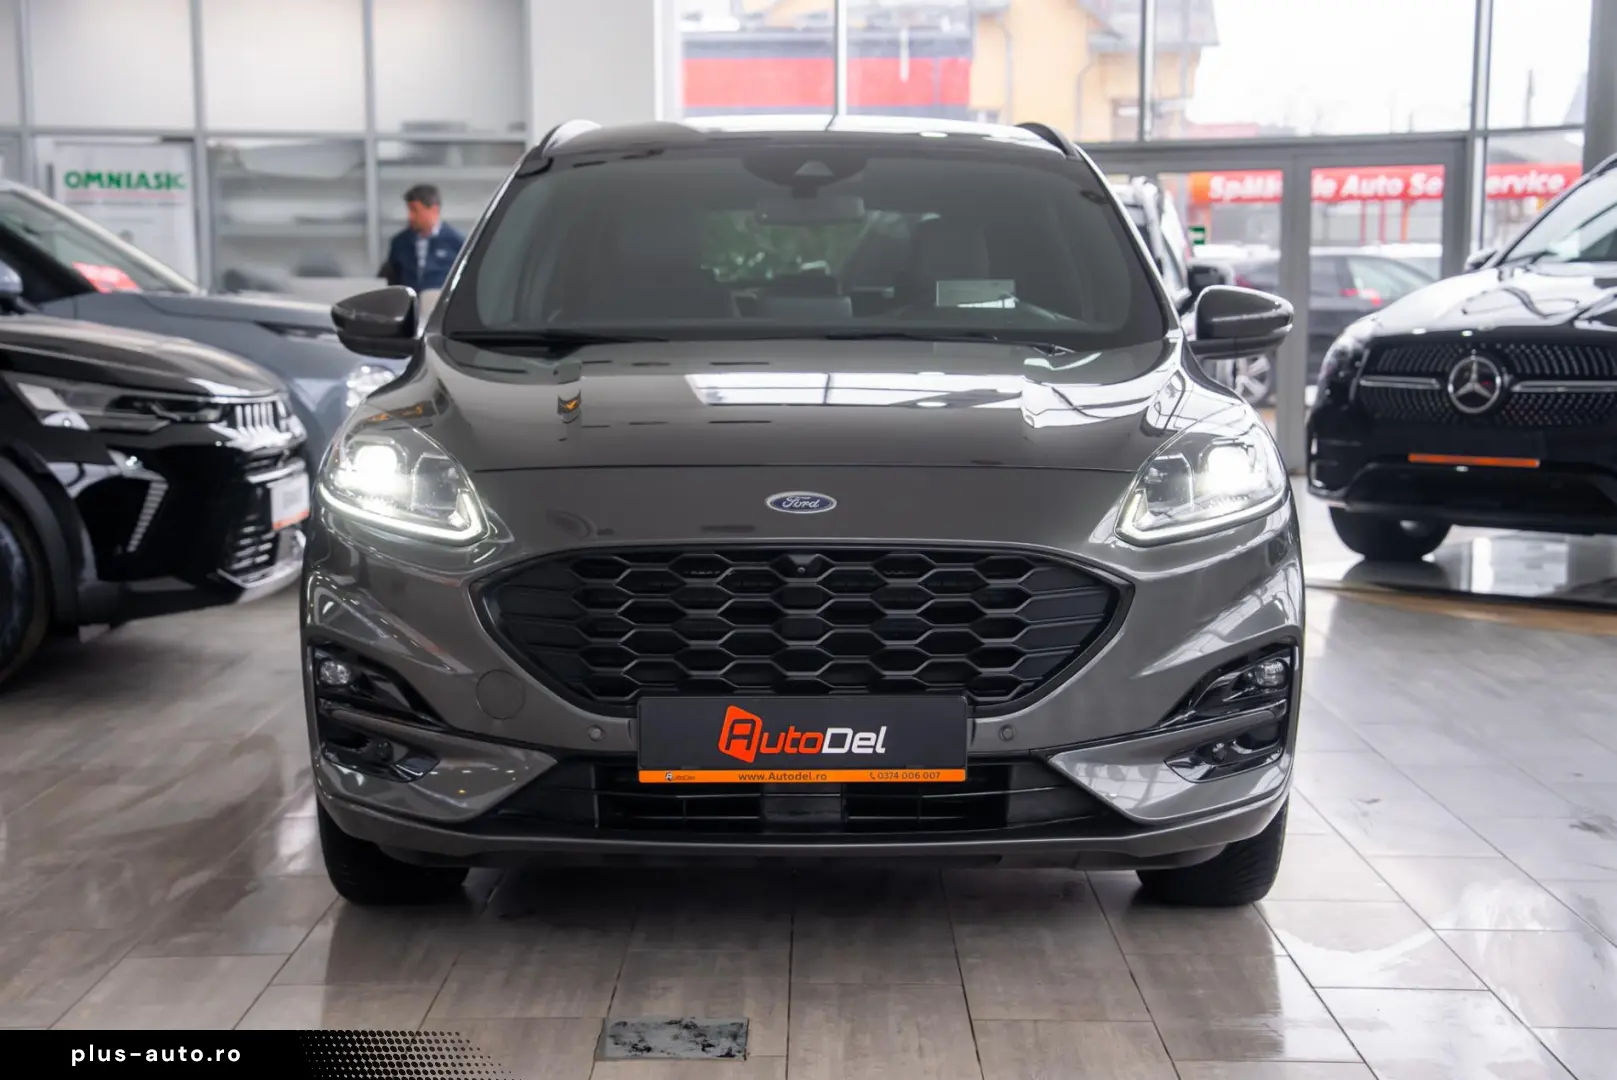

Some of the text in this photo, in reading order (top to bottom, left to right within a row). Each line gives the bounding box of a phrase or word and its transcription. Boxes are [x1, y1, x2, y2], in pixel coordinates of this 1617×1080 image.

[1341, 173, 1404, 198] Auto
[782, 496, 820, 508] Ford
[718, 705, 887, 763] AutoDel
[738, 771, 828, 781] www.Autodel.ro
